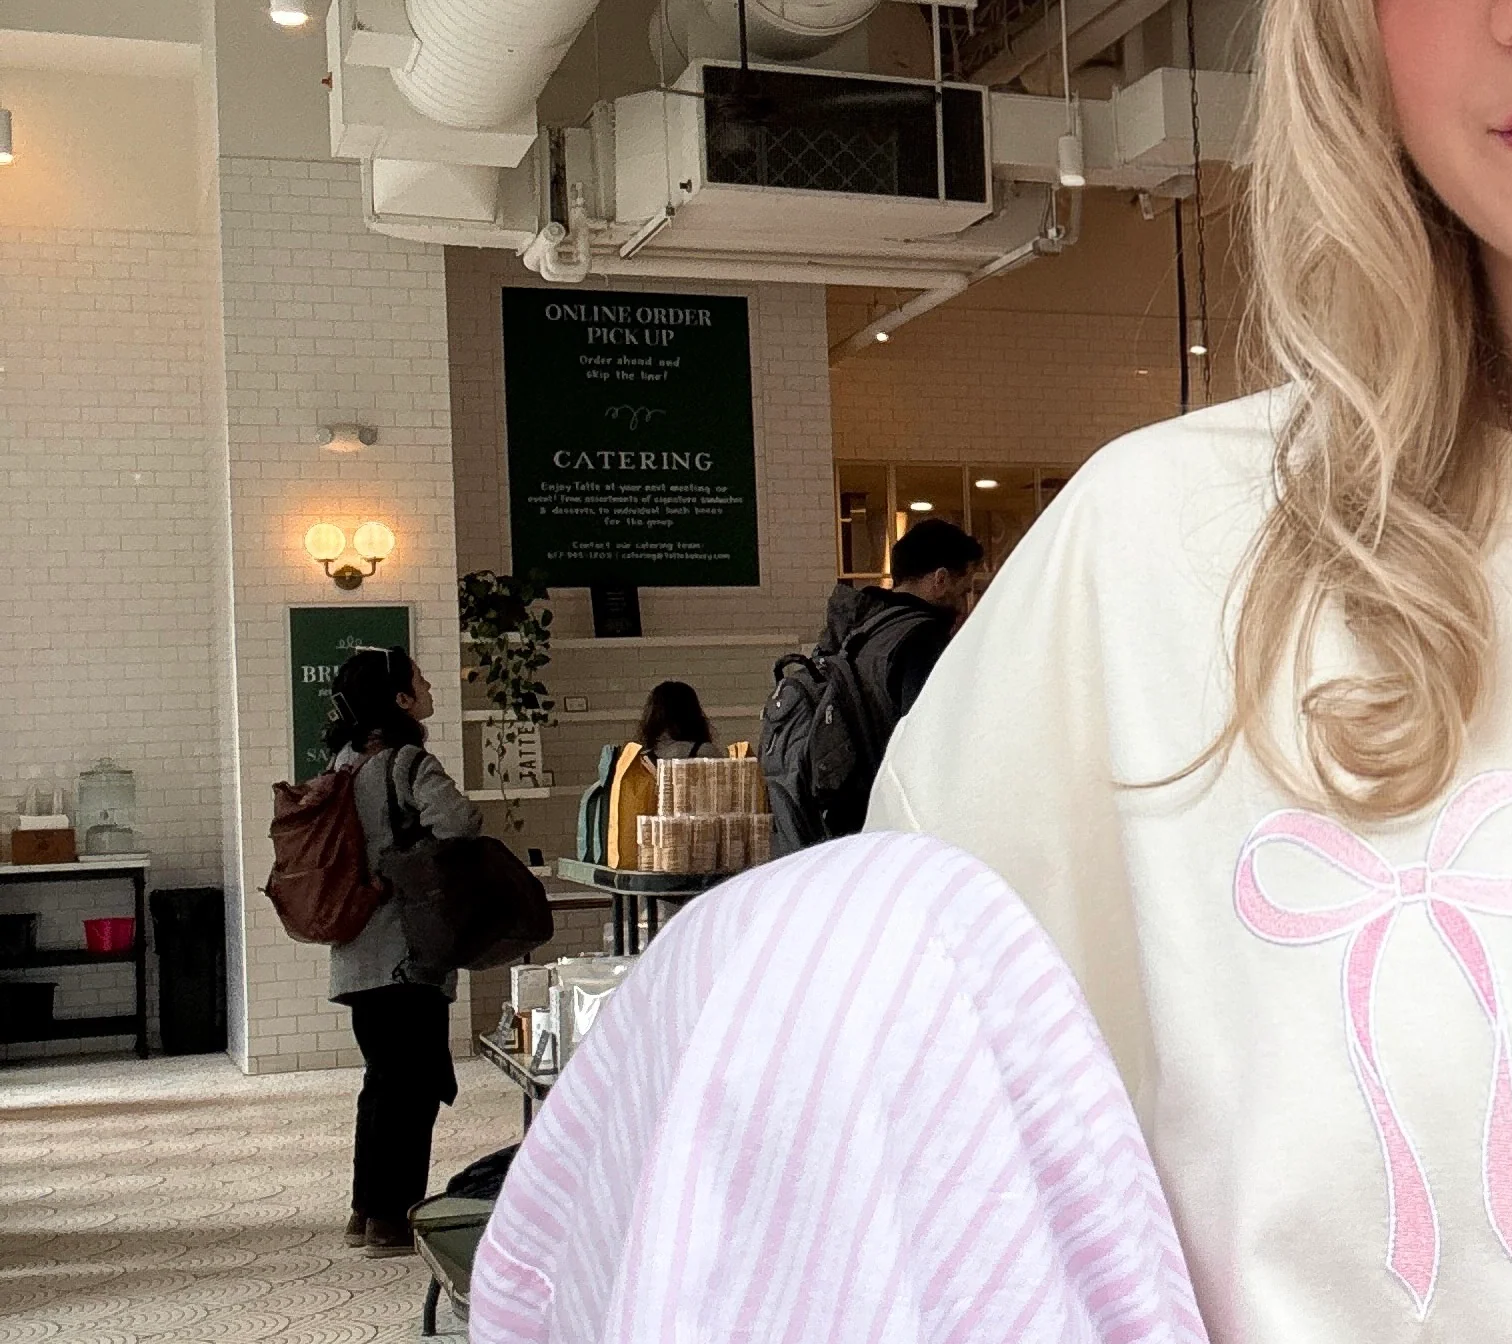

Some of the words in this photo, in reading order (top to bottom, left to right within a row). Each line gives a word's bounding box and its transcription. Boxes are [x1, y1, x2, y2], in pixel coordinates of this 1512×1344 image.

[544, 303, 632, 323] ONLINE
[635, 306, 712, 327] ORDER
[587, 327, 639, 345] PICK
[644, 329, 675, 347] UP
[579, 354, 613, 365] Order
[615, 370, 635, 381] the
[553, 450, 713, 471] CATERING
[541, 481, 572, 493] Enjoy
[604, 482, 616, 491] at
